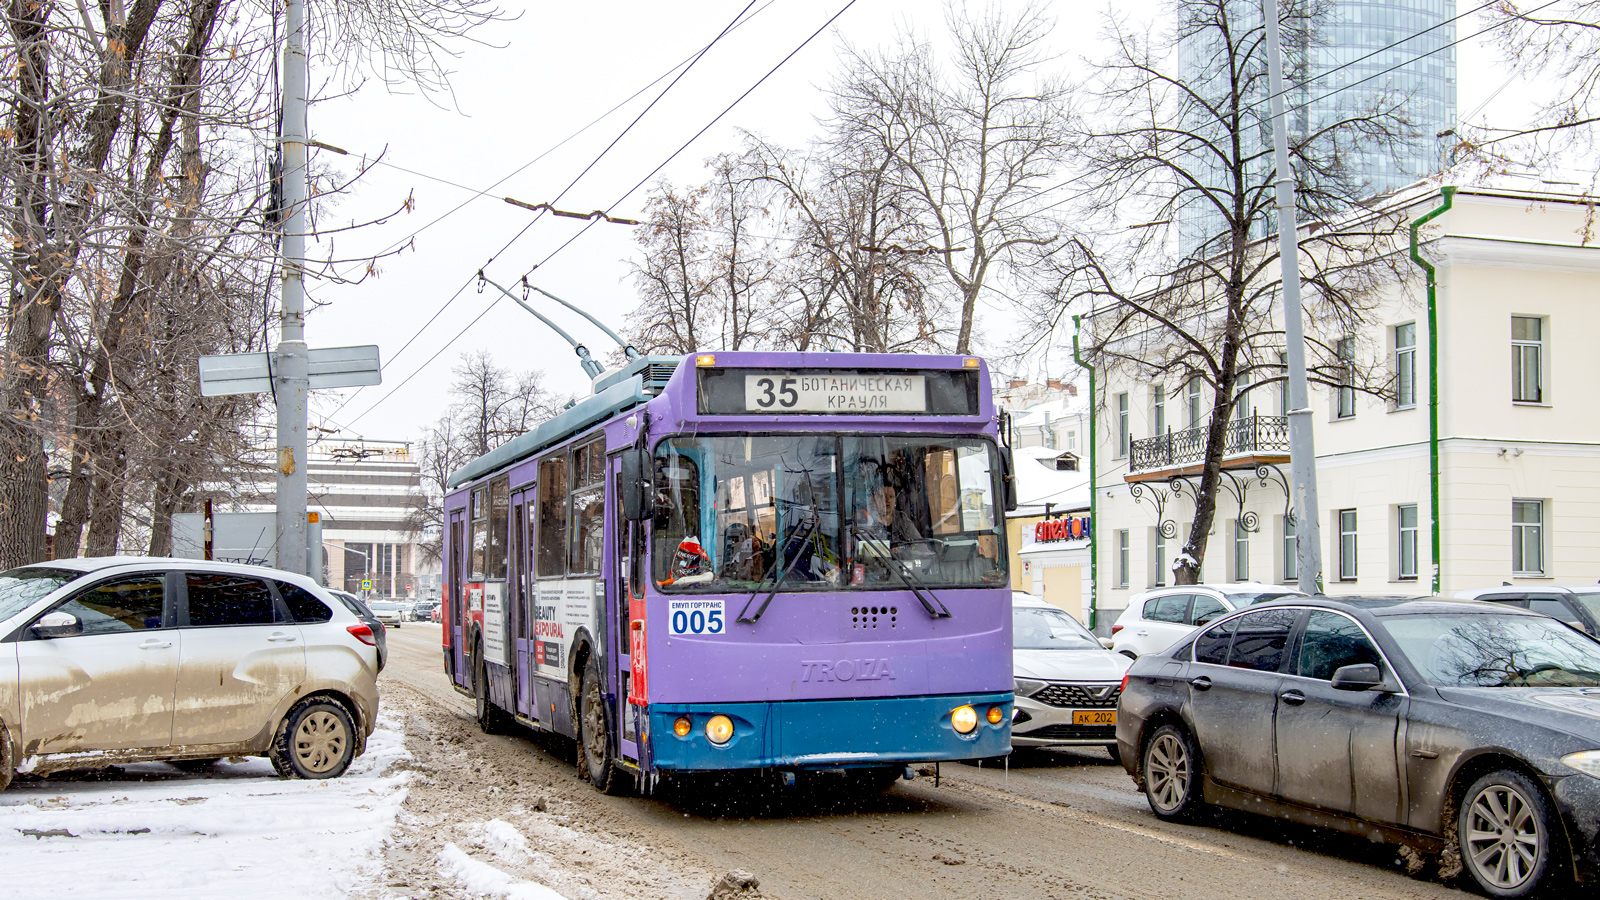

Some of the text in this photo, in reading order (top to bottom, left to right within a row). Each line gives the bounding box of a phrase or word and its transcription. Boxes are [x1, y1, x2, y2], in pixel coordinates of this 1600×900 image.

[756, 377, 913, 408] 35 БОТАНИЧЕСКАЯ
[828, 394, 888, 409] КРАУЛЯ
[1035, 516, 1091, 541] anextou
[535, 606, 556, 621] BEAUTY
[671, 601, 722, 609] ЕМУП ГОРТРАНС
[672, 610, 723, 634] 005
[801, 658, 896, 683] TROLZA
[1094, 712, 1113, 723] 202
